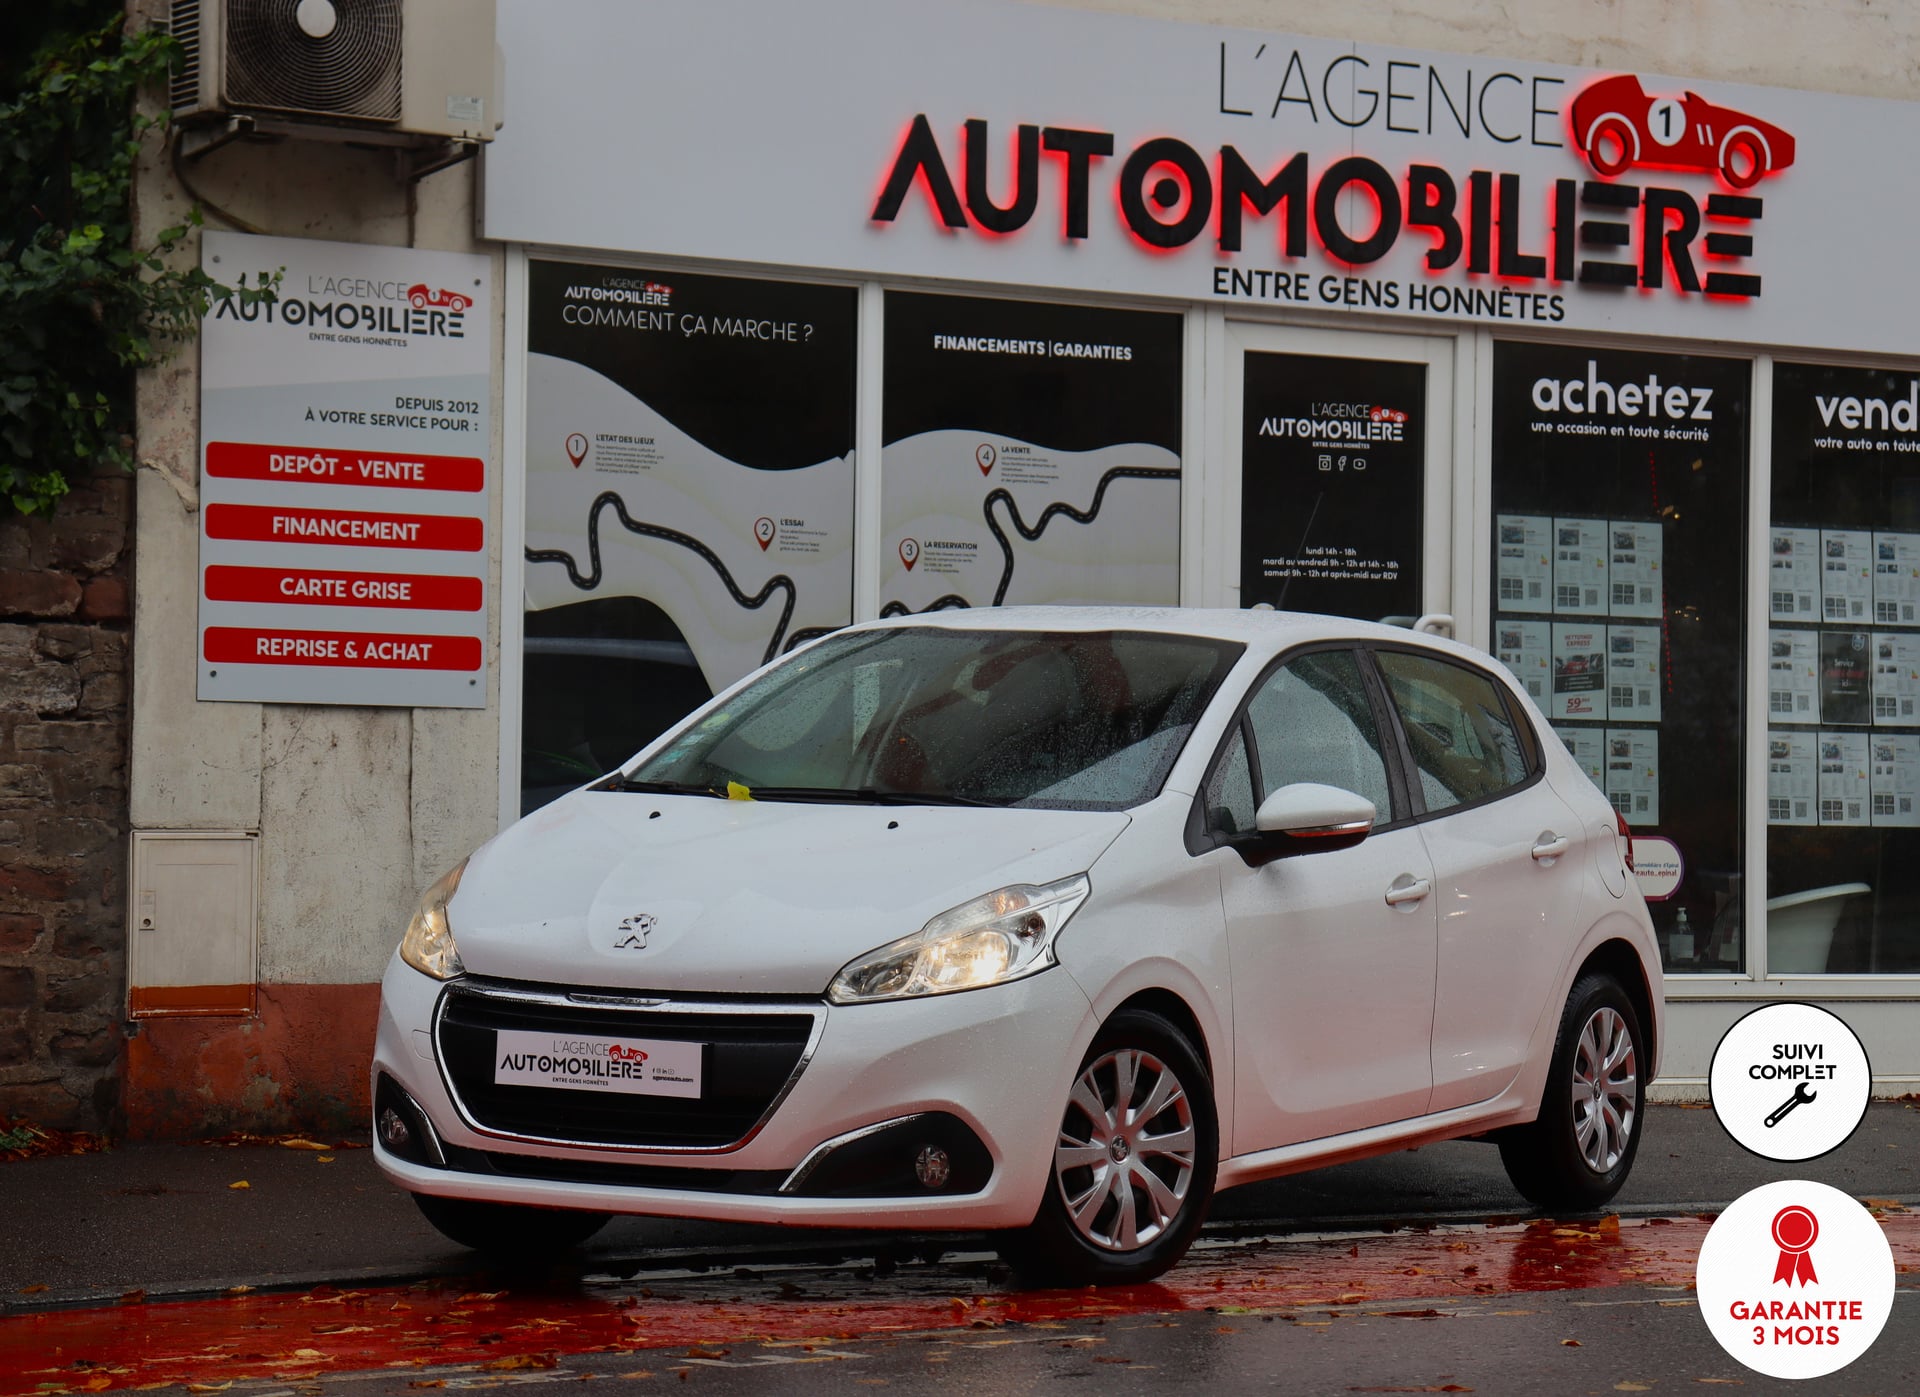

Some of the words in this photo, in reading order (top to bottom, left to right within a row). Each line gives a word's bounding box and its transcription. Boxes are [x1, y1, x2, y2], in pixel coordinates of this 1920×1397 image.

[1220, 41, 1566, 148] L'AGENCE
[1213, 268, 1310, 299] ENTRE
[1317, 276, 1400, 309] GENS
[1408, 284, 1566, 324] HONNÊTES
[562, 304, 675, 331] COMMENT
[680, 314, 707, 337] ÇA
[712, 316, 797, 342] MARCHE
[309, 333, 336, 343] ENTRE
[337, 334, 361, 344] GENS
[934, 335, 1045, 355] FINANCEMENTS
[1053, 343, 1132, 360] GARANTIES
[1532, 360, 1713, 420] achetez
[395, 397, 444, 411] DEPUIS
[447, 400, 479, 414] 2012
[1815, 380, 1920, 432] vend
[305, 407, 315, 421] À
[319, 410, 366, 424] VOTRE
[370, 413, 427, 429] SERVICE
[431, 417, 469, 431] POUR
[1531, 421, 1553, 433] une
[1557, 421, 1607, 436] occasion
[1610, 427, 1625, 436] en
[1629, 425, 1660, 438] toute
[1664, 425, 1709, 441] sécurité
[575, 440, 579, 451] 1
[1814, 436, 1843, 449] votre
[1847, 438, 1872, 450] auto
[1876, 441, 1890, 451] en
[982, 450, 990, 460] 4
[269, 453, 339, 476] DEPÔT
[358, 459, 425, 481] VENTE
[272, 516, 420, 541] FINANCEMENT
[762, 523, 769, 535] 2
[906, 544, 913, 556] 3
[1306, 546, 1324, 555] lundi
[1325, 547, 1337, 555] 14h
[1345, 548, 1357, 556] 18h
[1263, 557, 1284, 565] mardi
[1297, 558, 1328, 566] vendredi
[1330, 558, 1339, 566] 9h
[1346, 559, 1357, 567] 12h
[1368, 560, 1379, 568] 14h
[1264, 569, 1290, 577] samedi
[1292, 569, 1301, 577] 9h
[1308, 569, 1319, 577] 12h
[1383, 571, 1398, 580] RDV
[280, 577, 347, 598] CARTE
[351, 580, 411, 600] GRISE
[256, 637, 339, 658] REPRISE
[344, 641, 358, 659] &
[363, 642, 432, 661] ACHAT
